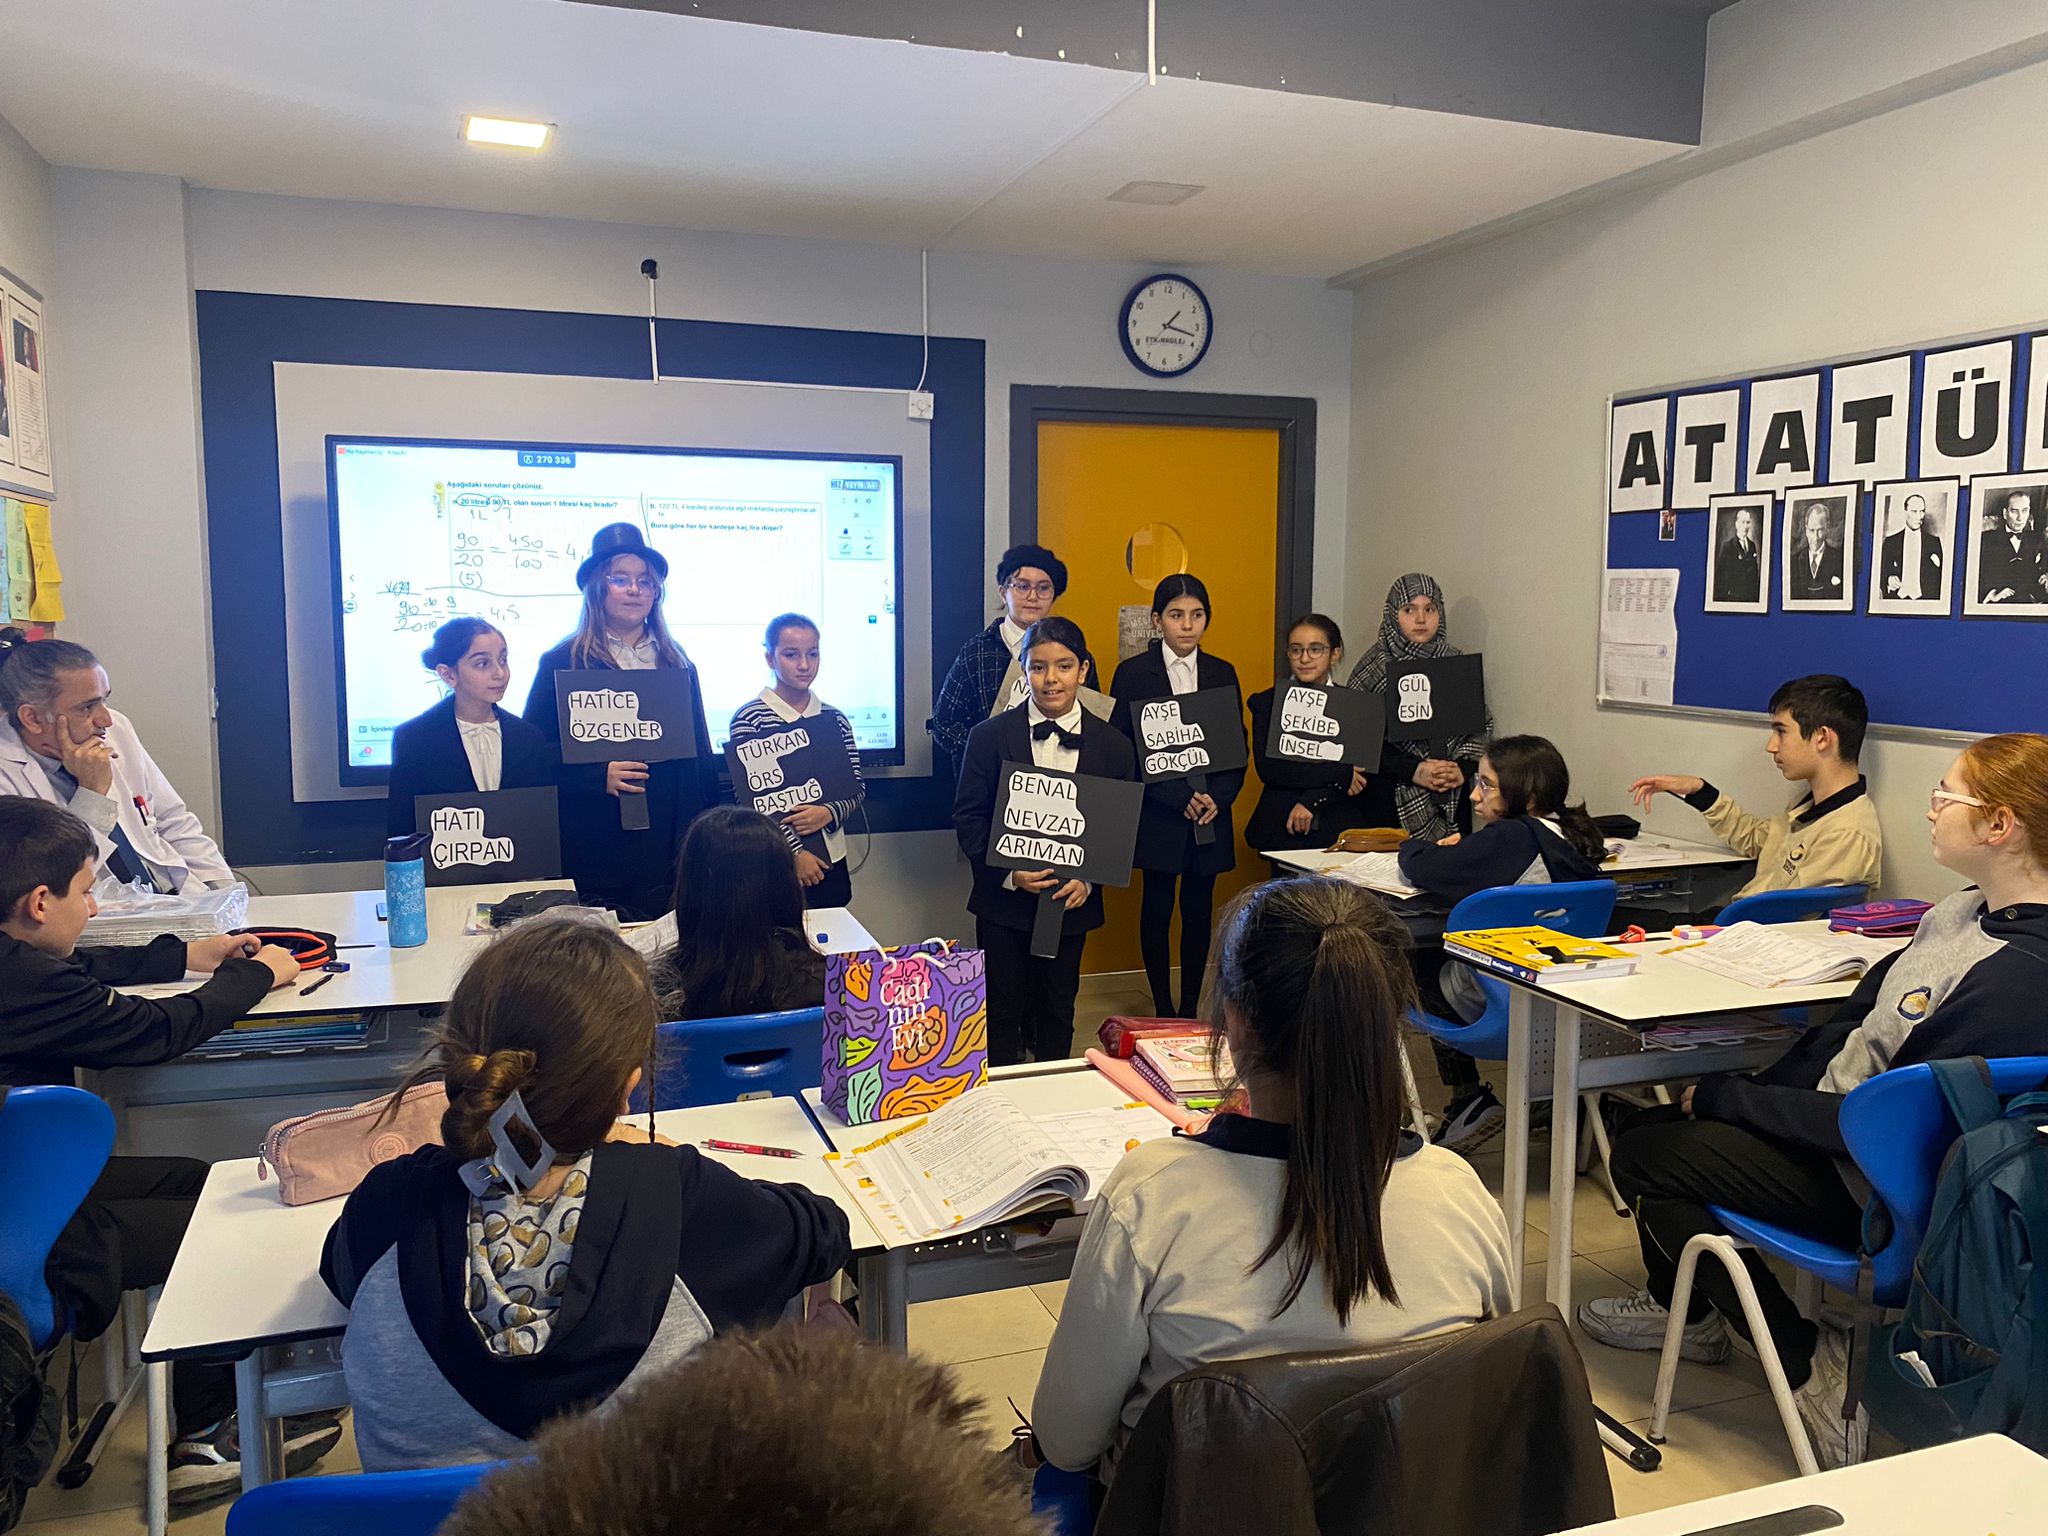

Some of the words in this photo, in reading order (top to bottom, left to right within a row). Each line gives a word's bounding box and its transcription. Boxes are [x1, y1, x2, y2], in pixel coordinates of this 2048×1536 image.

[1164, 285, 1172, 294] 12
[1182, 292, 1185, 300] 1
[1136, 302, 1144, 310] 10
[1191, 306, 1197, 314] 2
[1194, 323, 1200, 331] 3
[1135, 338, 1140, 346] 8
[1146, 352, 1152, 360] 7
[1162, 358, 1167, 366] 6
[1618, 367, 2048, 489] ATATÜ
[536, 455, 554, 464] 270
[554, 456, 572, 465] 336
[447, 481, 482, 490] Aşağıdaki
[512, 482, 544, 490] çözünüz.
[580, 500, 592, 508] kaç
[650, 522, 668, 530] Buna
[709, 524, 734, 532] kardeşe
[457, 532, 479, 550] 90
[508, 533, 544, 549] 450
[454, 553, 484, 568] 20
[514, 558, 543, 570] 100
[1400, 676, 1428, 692] GÜL
[570, 690, 636, 710] HATİCE
[1288, 690, 1326, 708] AYŞE
[1143, 702, 1178, 722] AYŞE
[1400, 704, 1430, 719] ESİN
[572, 719, 661, 738] ÖZGENER
[1282, 714, 1336, 735] ŞEKİBE
[740, 730, 808, 762] TÜRKAN
[1146, 726, 1203, 748] SABİHA
[1280, 736, 1323, 758] İNSEL
[1146, 750, 1208, 772] GÖKÇÜL
[748, 768, 783, 790] ÖRS
[1012, 775, 1076, 801] BENAL
[756, 779, 820, 814] BAŞTUĞ
[434, 811, 480, 832] HATI
[1006, 808, 1084, 835] NEVZAT
[434, 840, 511, 867] ÇIRPAN
[998, 836, 1084, 865] ARIMAN
[891, 1023, 924, 1050] Evi
